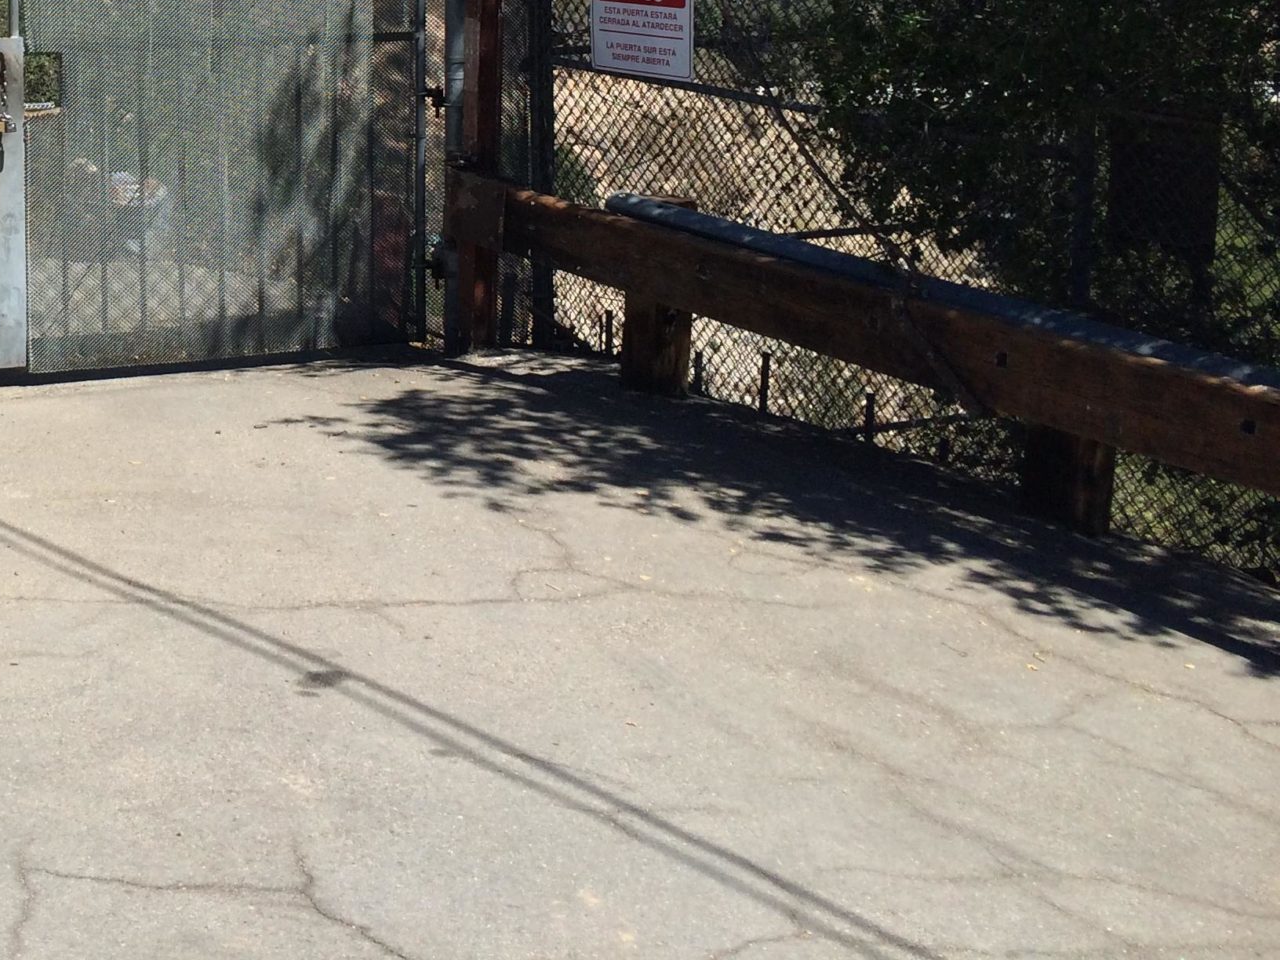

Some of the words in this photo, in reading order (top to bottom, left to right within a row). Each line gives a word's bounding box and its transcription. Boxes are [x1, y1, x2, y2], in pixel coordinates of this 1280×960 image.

[604, 6, 620, 14] ESTA
[622, 8, 648, 17] PUERTA
[599, 16, 630, 26] CERRADA
[642, 21, 683, 32] ATARDECER
[616, 43, 641, 52] PUERTA
[643, 46, 657, 54] SUR
[612, 53, 640, 62] SIEMPRE
[641, 56, 670, 67] ABIERTA
